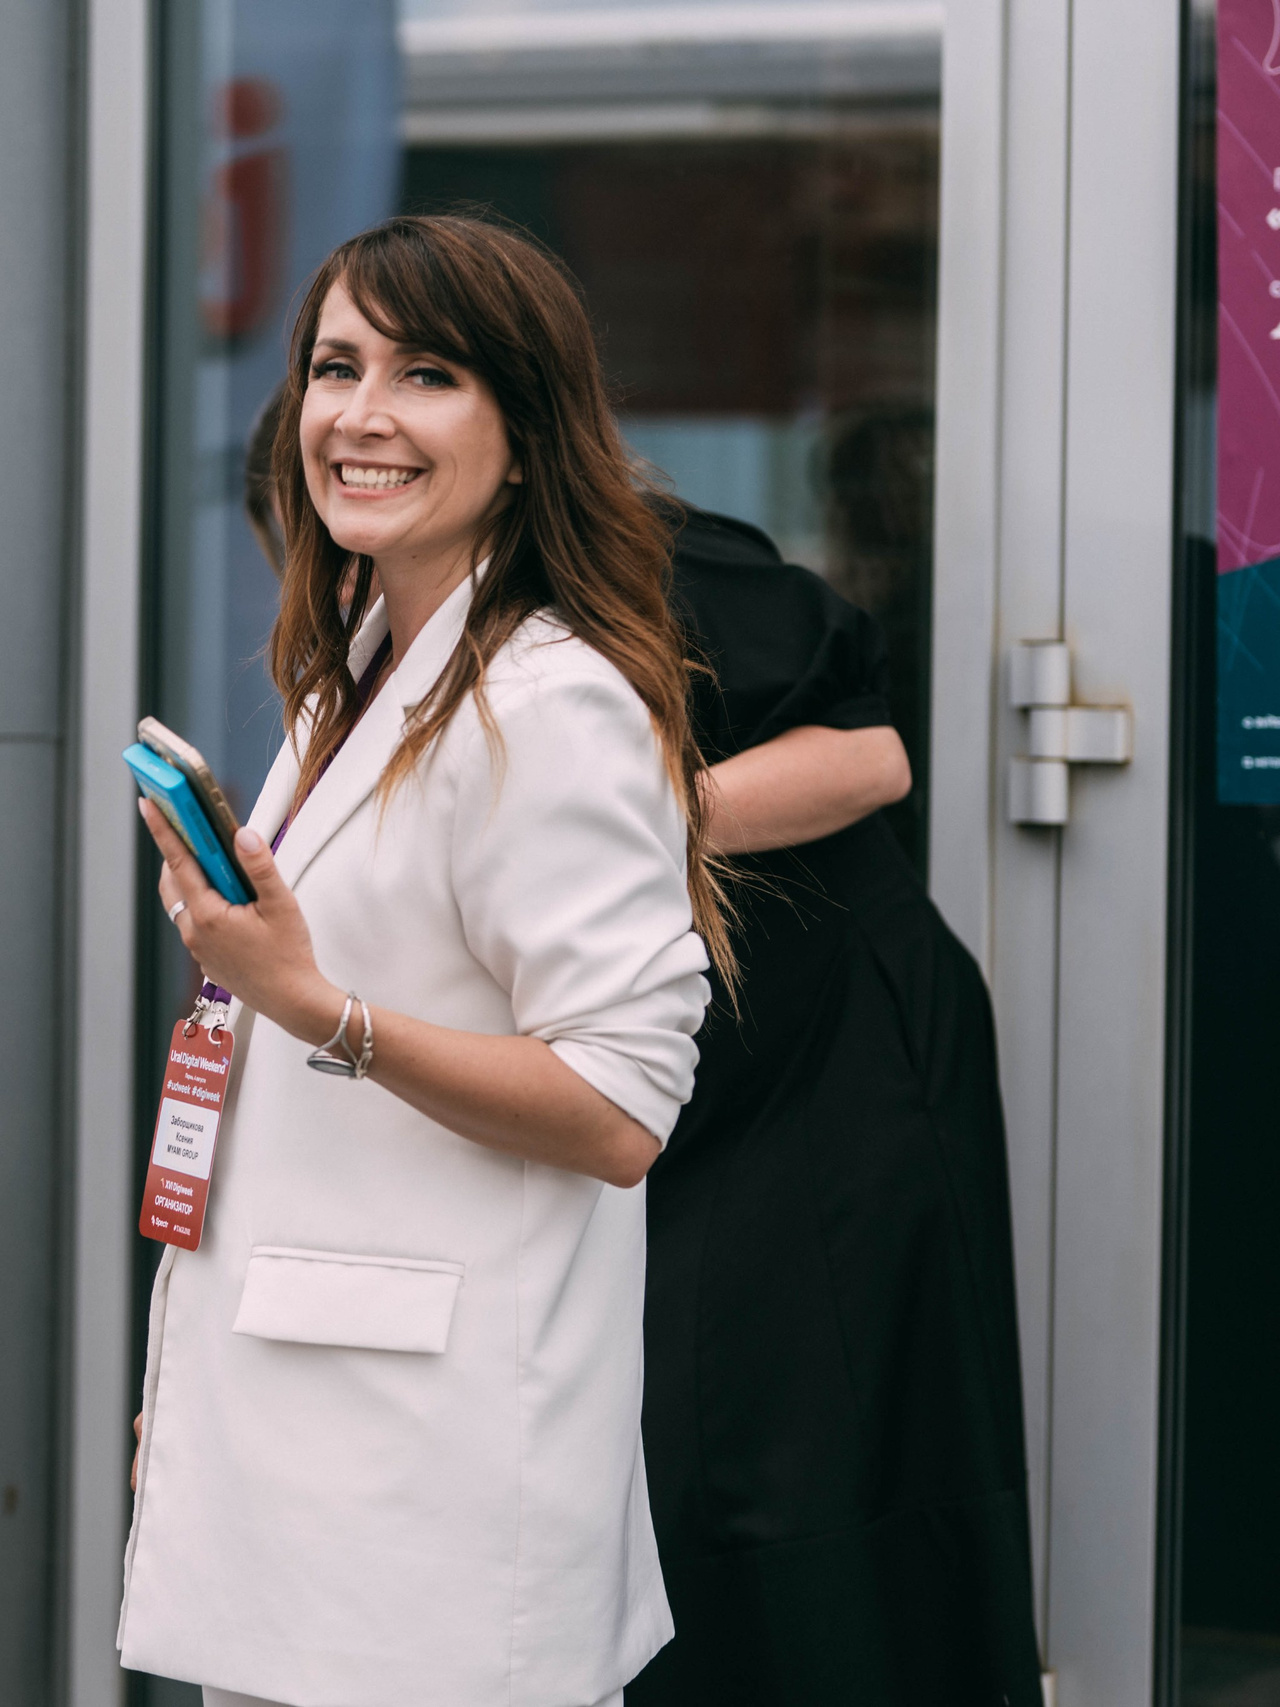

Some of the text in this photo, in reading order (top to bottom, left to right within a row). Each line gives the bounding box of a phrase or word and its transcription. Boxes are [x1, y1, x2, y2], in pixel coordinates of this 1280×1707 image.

[171, 1049, 183, 1063] Ural
[182, 1052, 200, 1069] Digital
[200, 1056, 226, 1075] Weekend
[182, 1148, 199, 1160] GROUP
[173, 1181, 194, 1197] Digiweek
[155, 1194, 194, 1215] ОРГАНИЗАТОР
